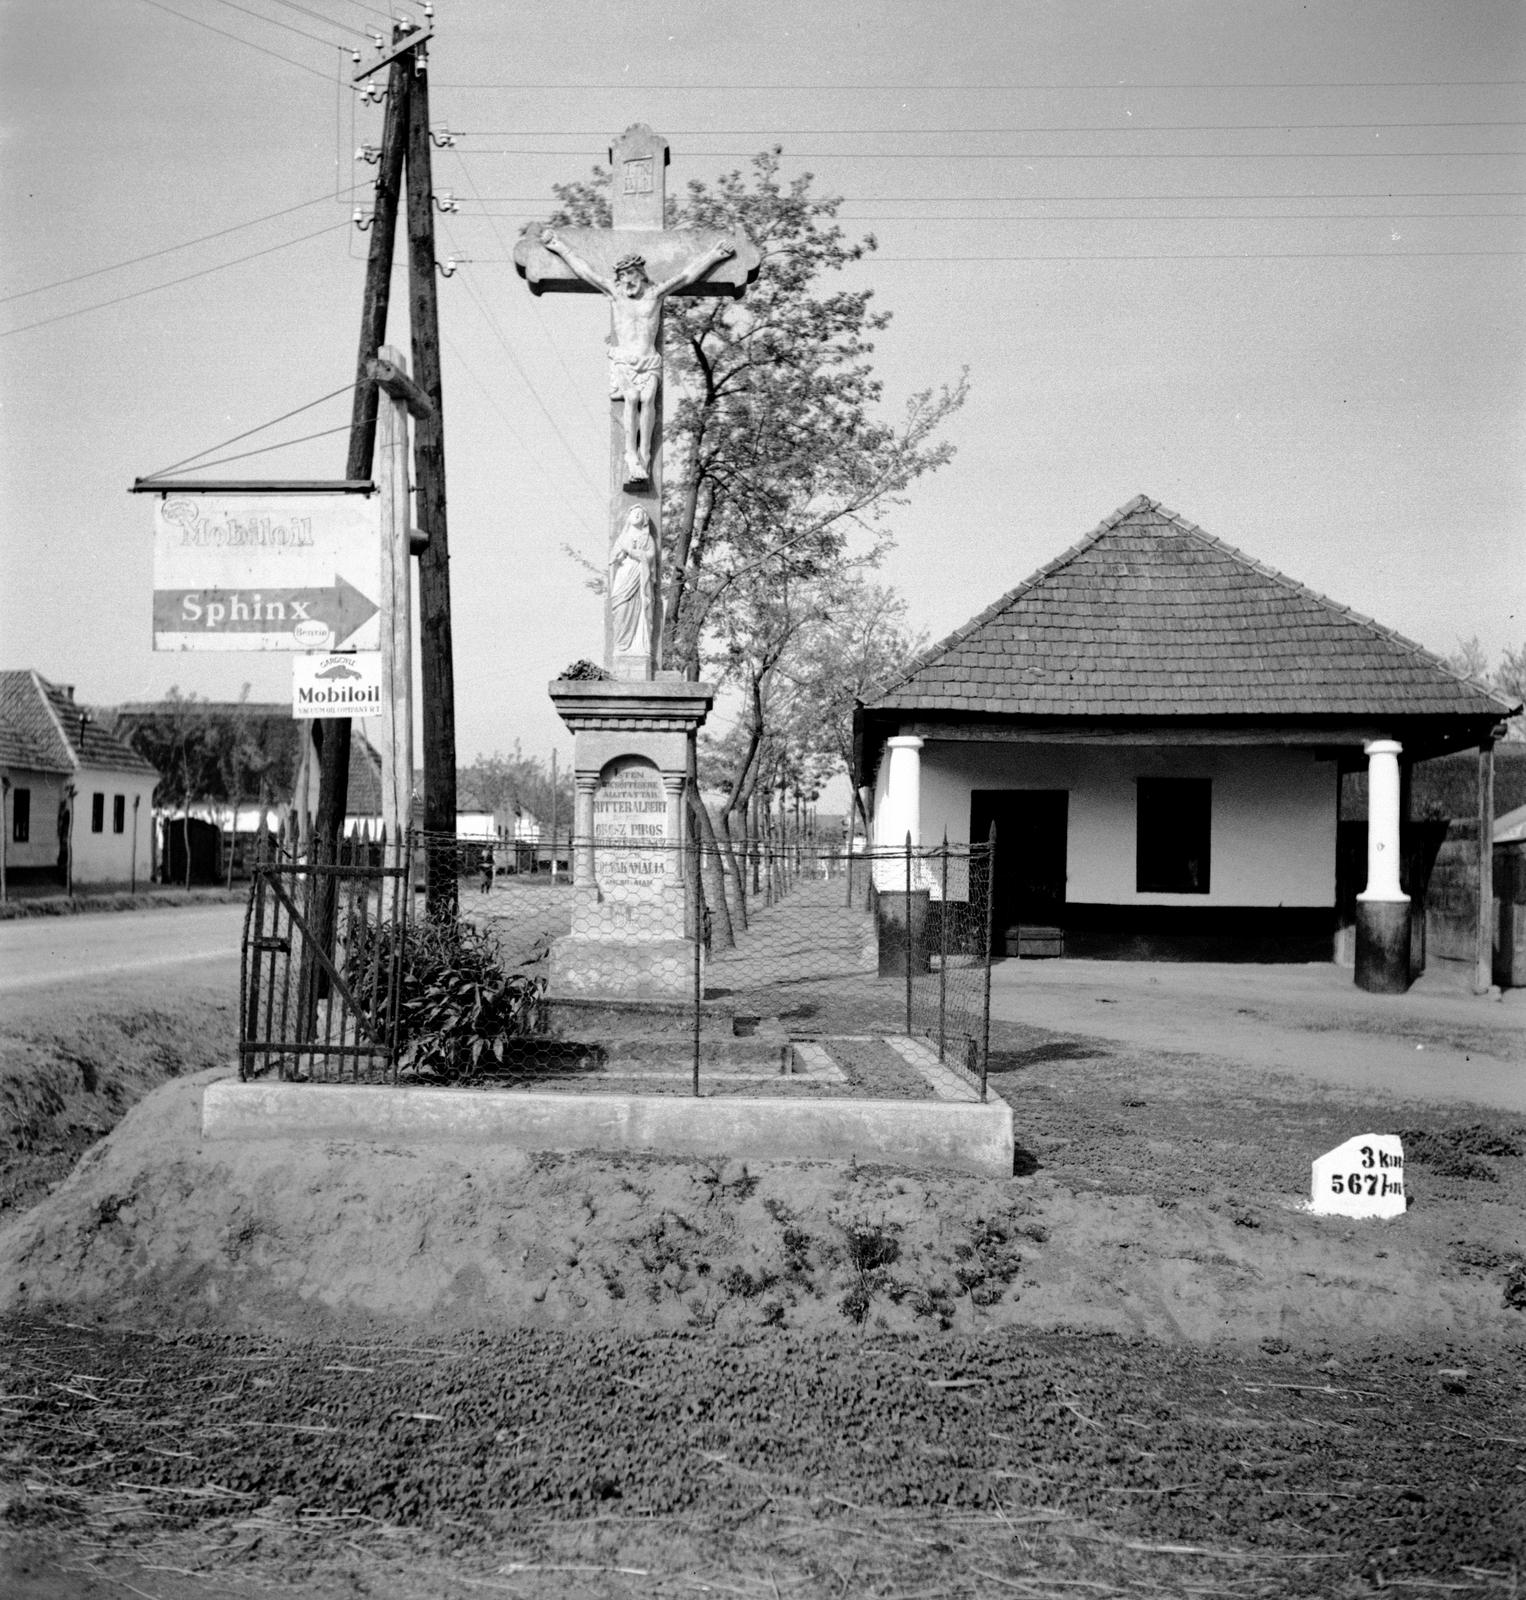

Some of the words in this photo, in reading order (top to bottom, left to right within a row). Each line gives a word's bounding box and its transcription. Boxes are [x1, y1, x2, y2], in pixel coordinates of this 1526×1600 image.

[180, 517, 314, 547] Mobiloil
[181, 594, 311, 627] Sphinx
[319, 656, 356, 668] GARGOYLE
[298, 685, 380, 704] Mobiloil
[630, 823, 663, 836] PIROS
[1360, 1146, 1375, 1168] 3
[1379, 1149, 1402, 1168] km
